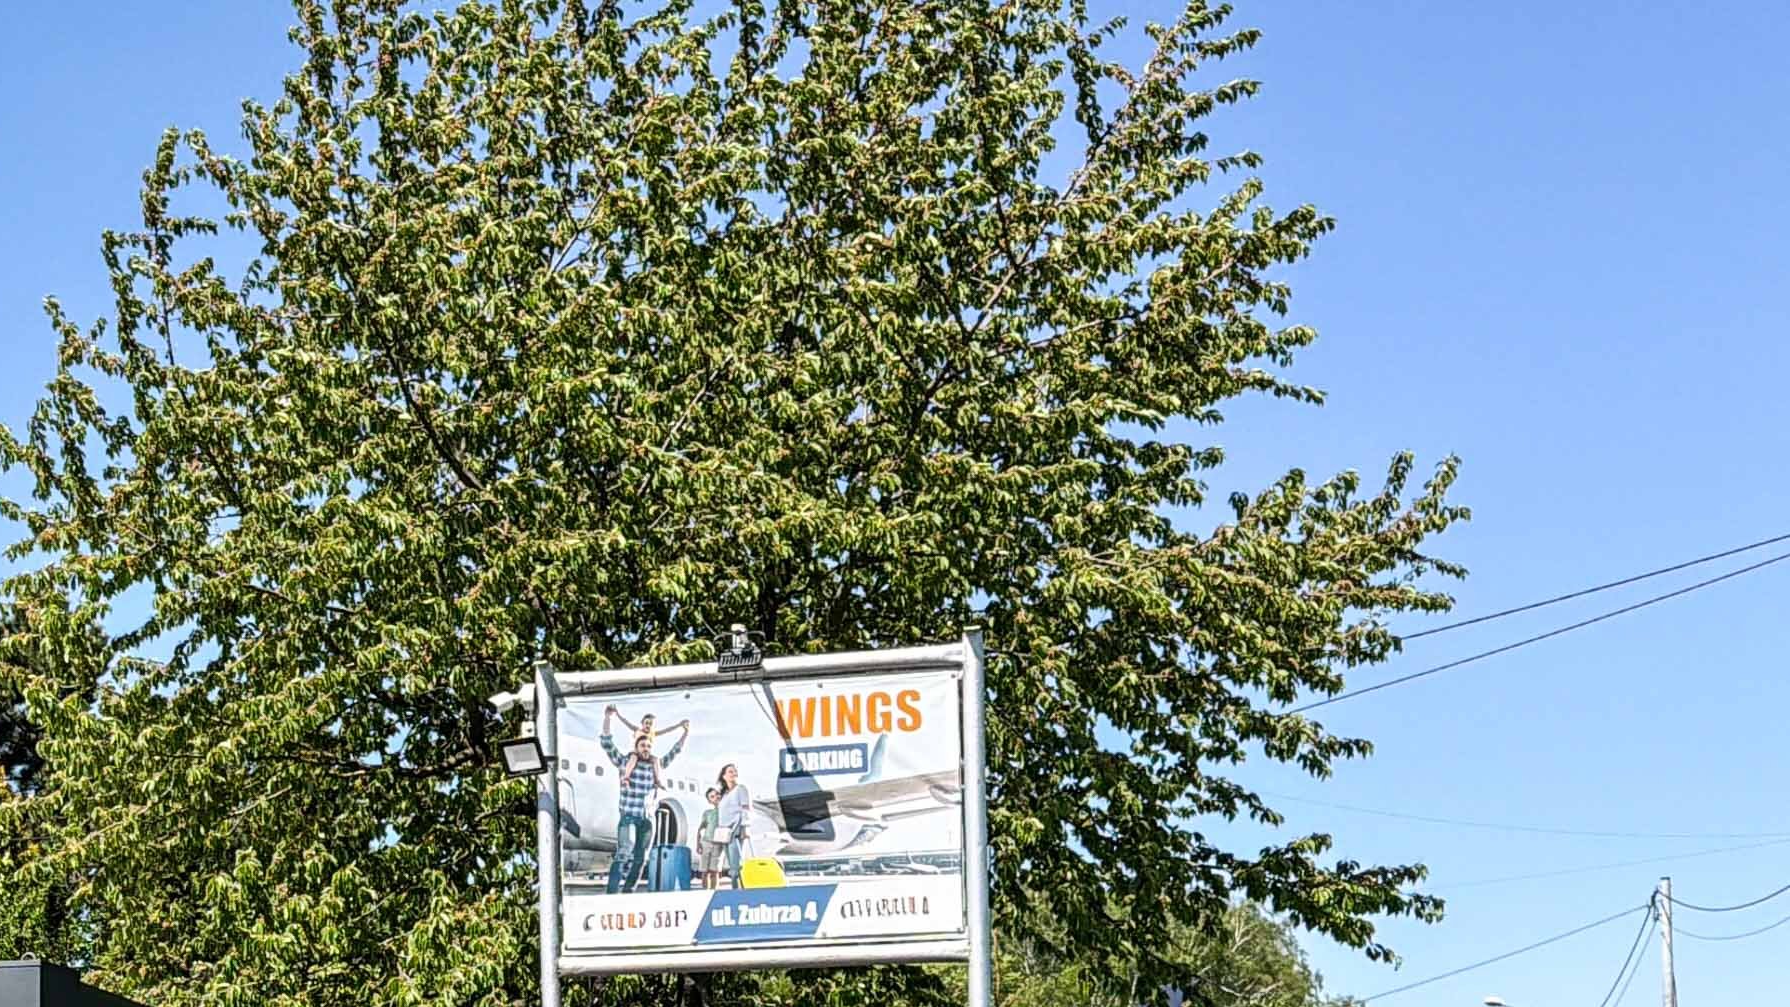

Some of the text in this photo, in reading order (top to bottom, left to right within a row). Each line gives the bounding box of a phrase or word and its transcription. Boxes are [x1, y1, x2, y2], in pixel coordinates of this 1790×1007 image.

[776, 689, 923, 739] WINGS
[784, 747, 864, 773] PARKING
[737, 903, 802, 925] Zubrza
[804, 900, 819, 922] 4
